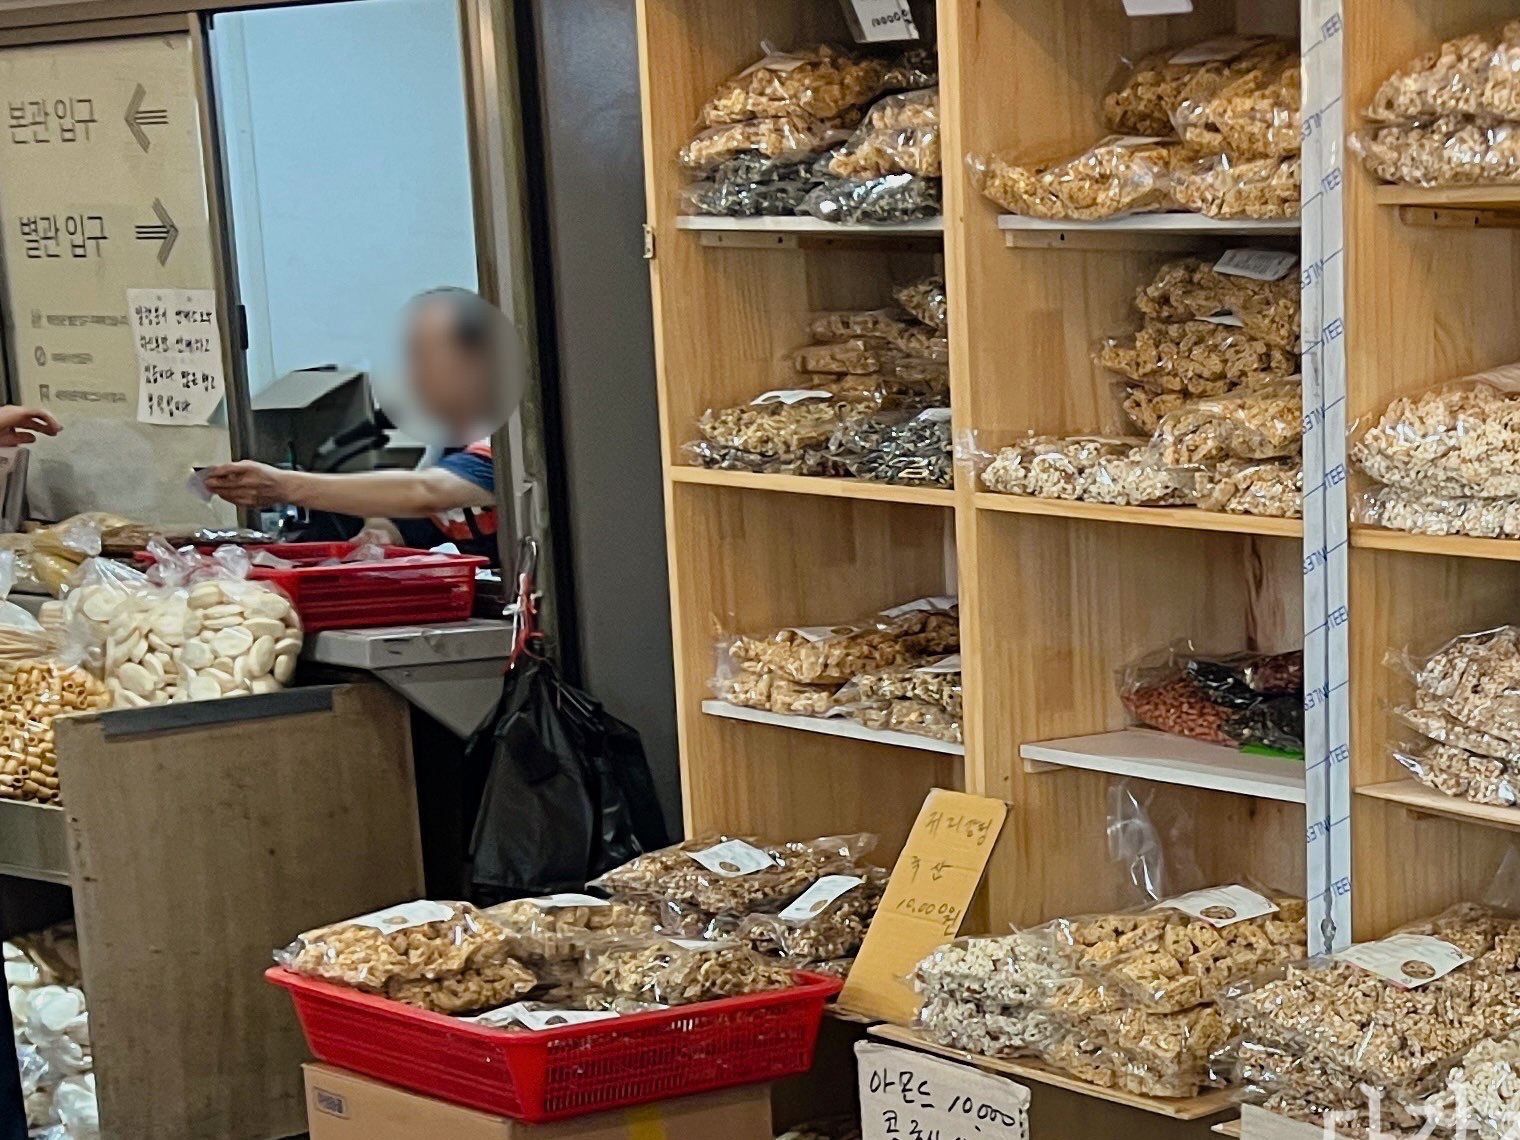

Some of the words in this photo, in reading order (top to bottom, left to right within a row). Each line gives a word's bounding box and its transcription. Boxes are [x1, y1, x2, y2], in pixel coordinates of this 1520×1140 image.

[9, 98, 50, 144] 본관
[54, 97, 98, 142] 입구
[19, 214, 61, 258] 별관
[65, 214, 109, 258] 입구
[870, 1067, 935, 1109] 아몬드
